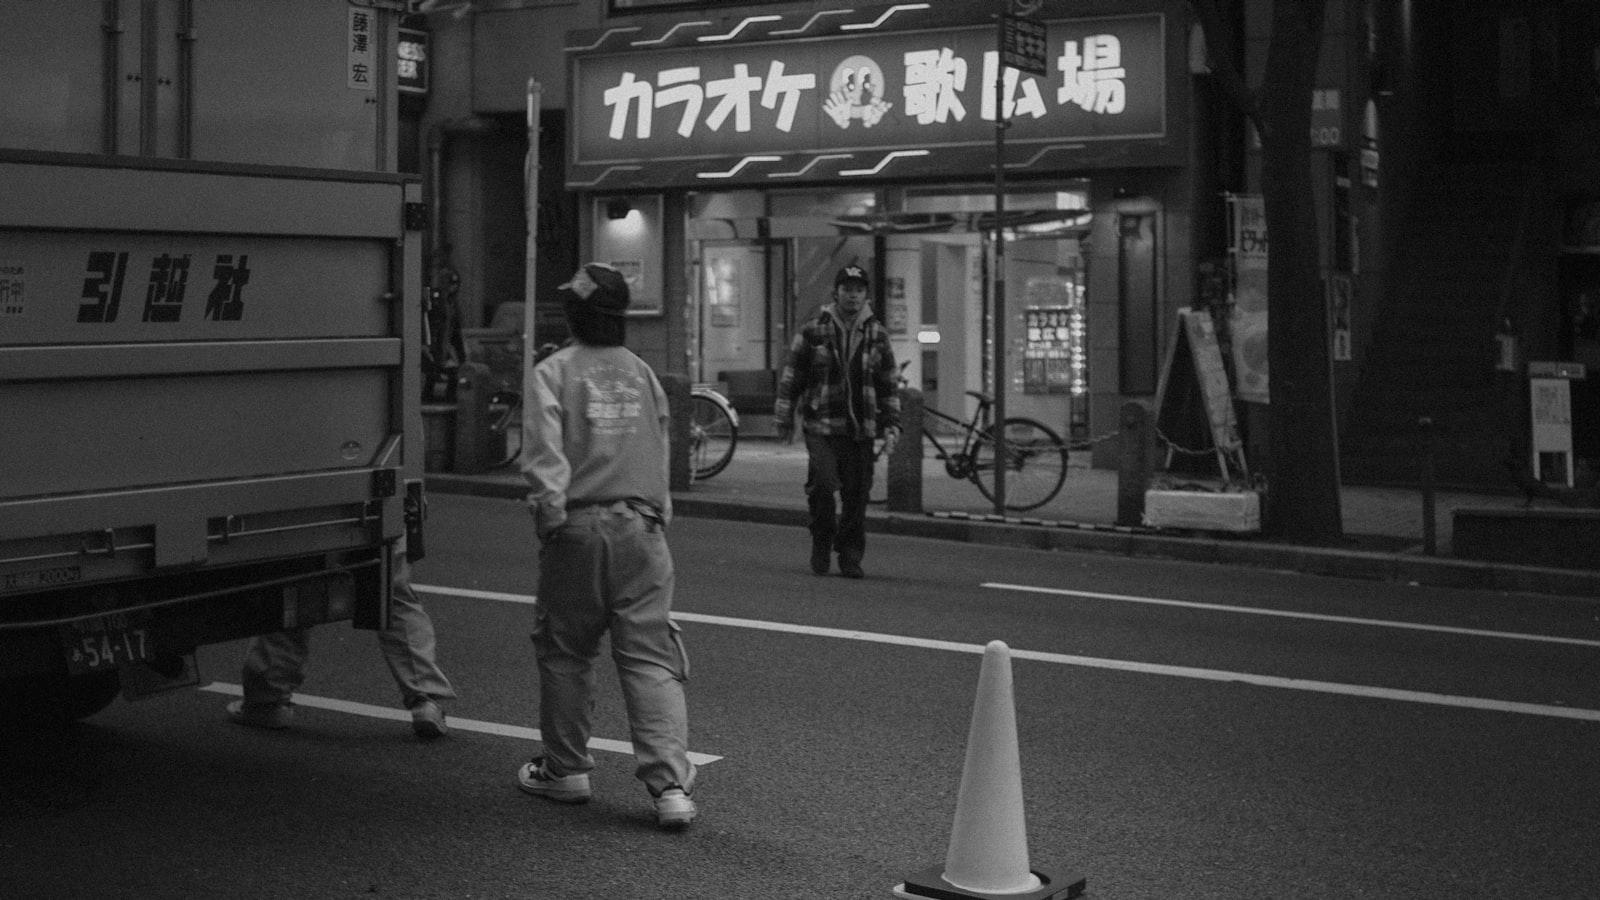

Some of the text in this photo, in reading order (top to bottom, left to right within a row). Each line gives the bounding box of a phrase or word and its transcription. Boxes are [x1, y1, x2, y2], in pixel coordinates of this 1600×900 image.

[352, 62, 369, 84] 宏
[603, 60, 817, 140] カラオケ
[904, 34, 1127, 125] 歌広場
[77, 251, 251, 323] 引越社
